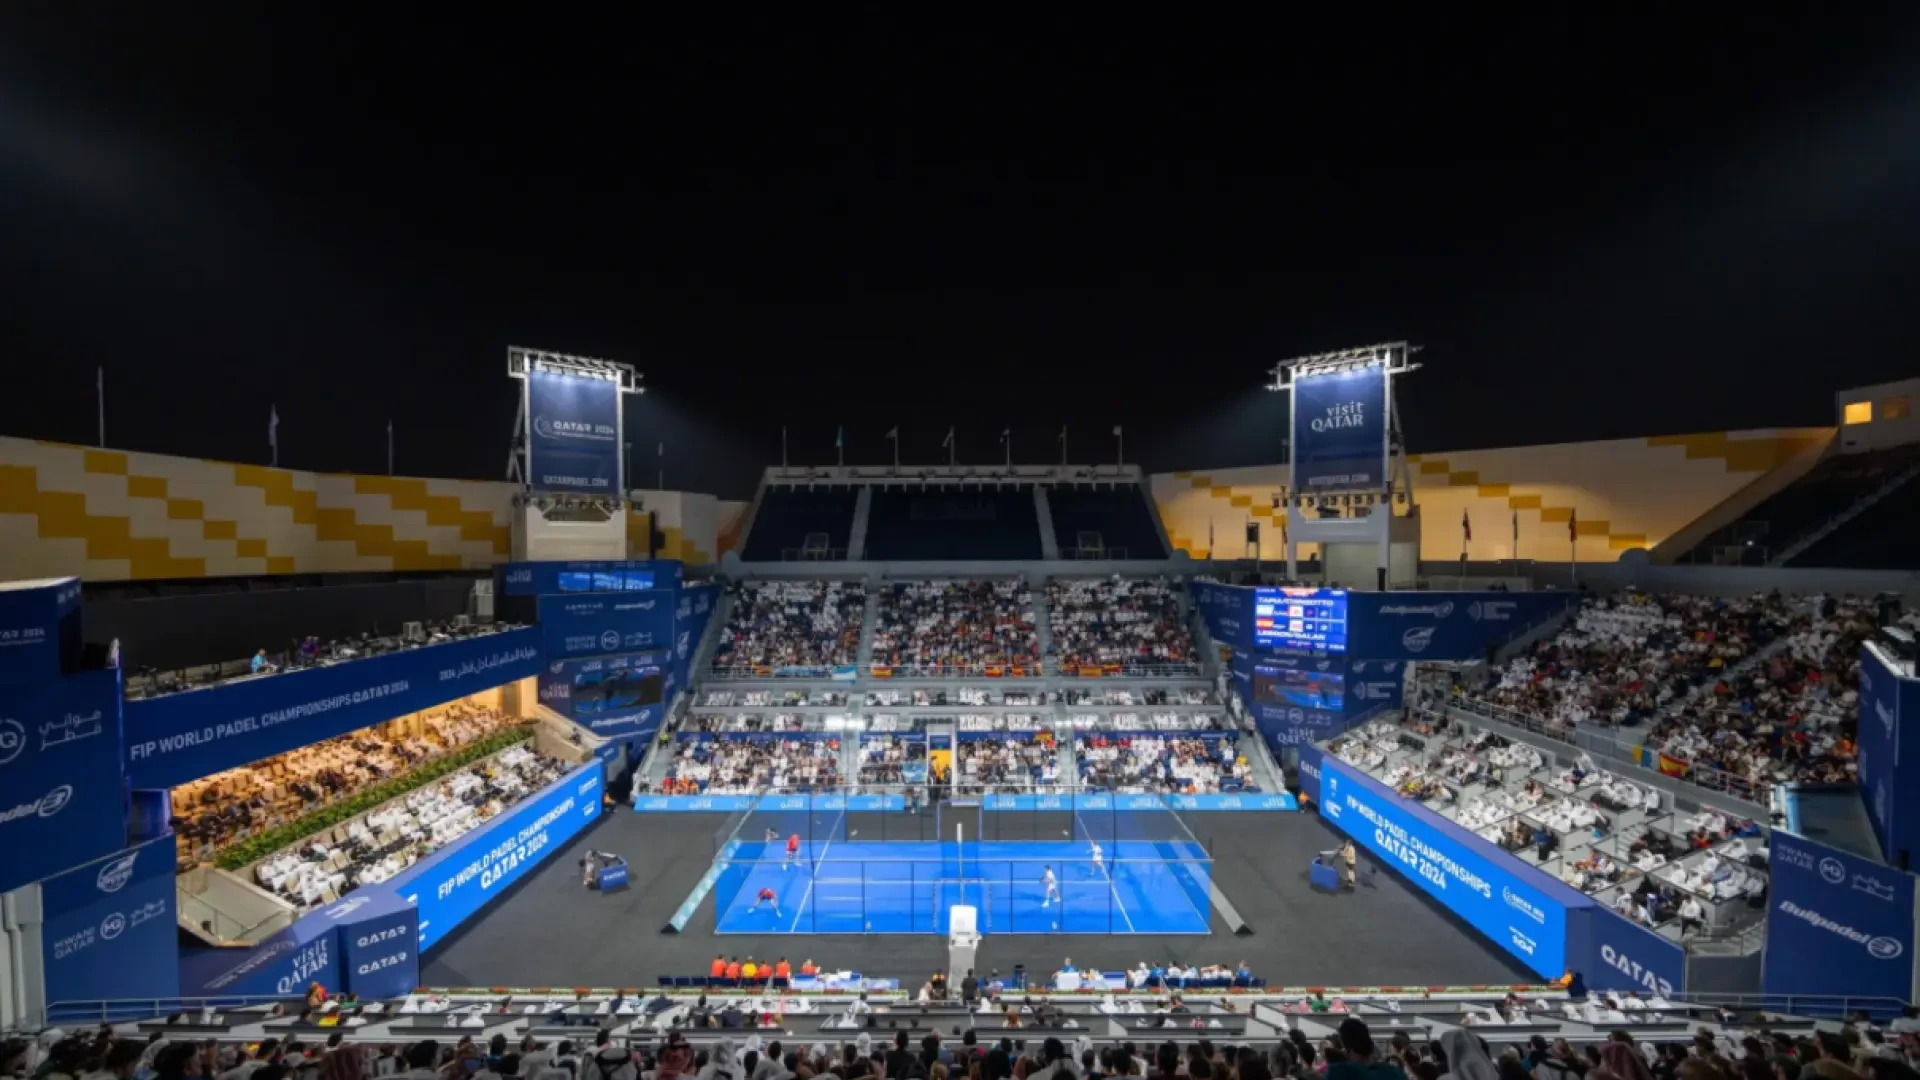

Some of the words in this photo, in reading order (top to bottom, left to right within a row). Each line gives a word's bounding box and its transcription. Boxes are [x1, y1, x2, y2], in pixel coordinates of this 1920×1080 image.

[1311, 414, 1363, 432] QATAR
[1326, 401, 1364, 417] visit
[553, 421, 592, 432] QATAR
[595, 424, 614, 435] 2024
[130, 741, 157, 760] FIP
[158, 726, 214, 753] WORLD
[216, 716, 260, 739] PADEL
[261, 692, 352, 727] CHAMPIONSHIPS
[351, 685, 391, 704] QATAR
[390, 680, 409, 695] 2024
[438, 876, 457, 900] FIP
[457, 854, 490, 887] WORLD
[491, 836, 518, 863] PADEL
[518, 796, 575, 843] CHAMPIONSHIPS
[480, 845, 527, 889] QATAR
[527, 829, 549, 857] 2024
[1346, 794, 1358, 812] FIP
[1358, 803, 1383, 828] WORLD
[1384, 818, 1409, 846] PADEL
[1410, 836, 1491, 898] CHAMPIONSHIPS
[1375, 828, 1418, 869] QATAR
[1419, 858, 1447, 890] 2024
[1777, 851, 1813, 871] QATAR
[357, 925, 407, 947] QATAR
[1779, 900, 1870, 944] Bullpadel
[54, 936, 96, 960] QATAR
[292, 938, 328, 968] visit
[357, 952, 407, 975] QATAR
[277, 952, 328, 993] QATAR
[1601, 943, 1673, 1000] QATAR
